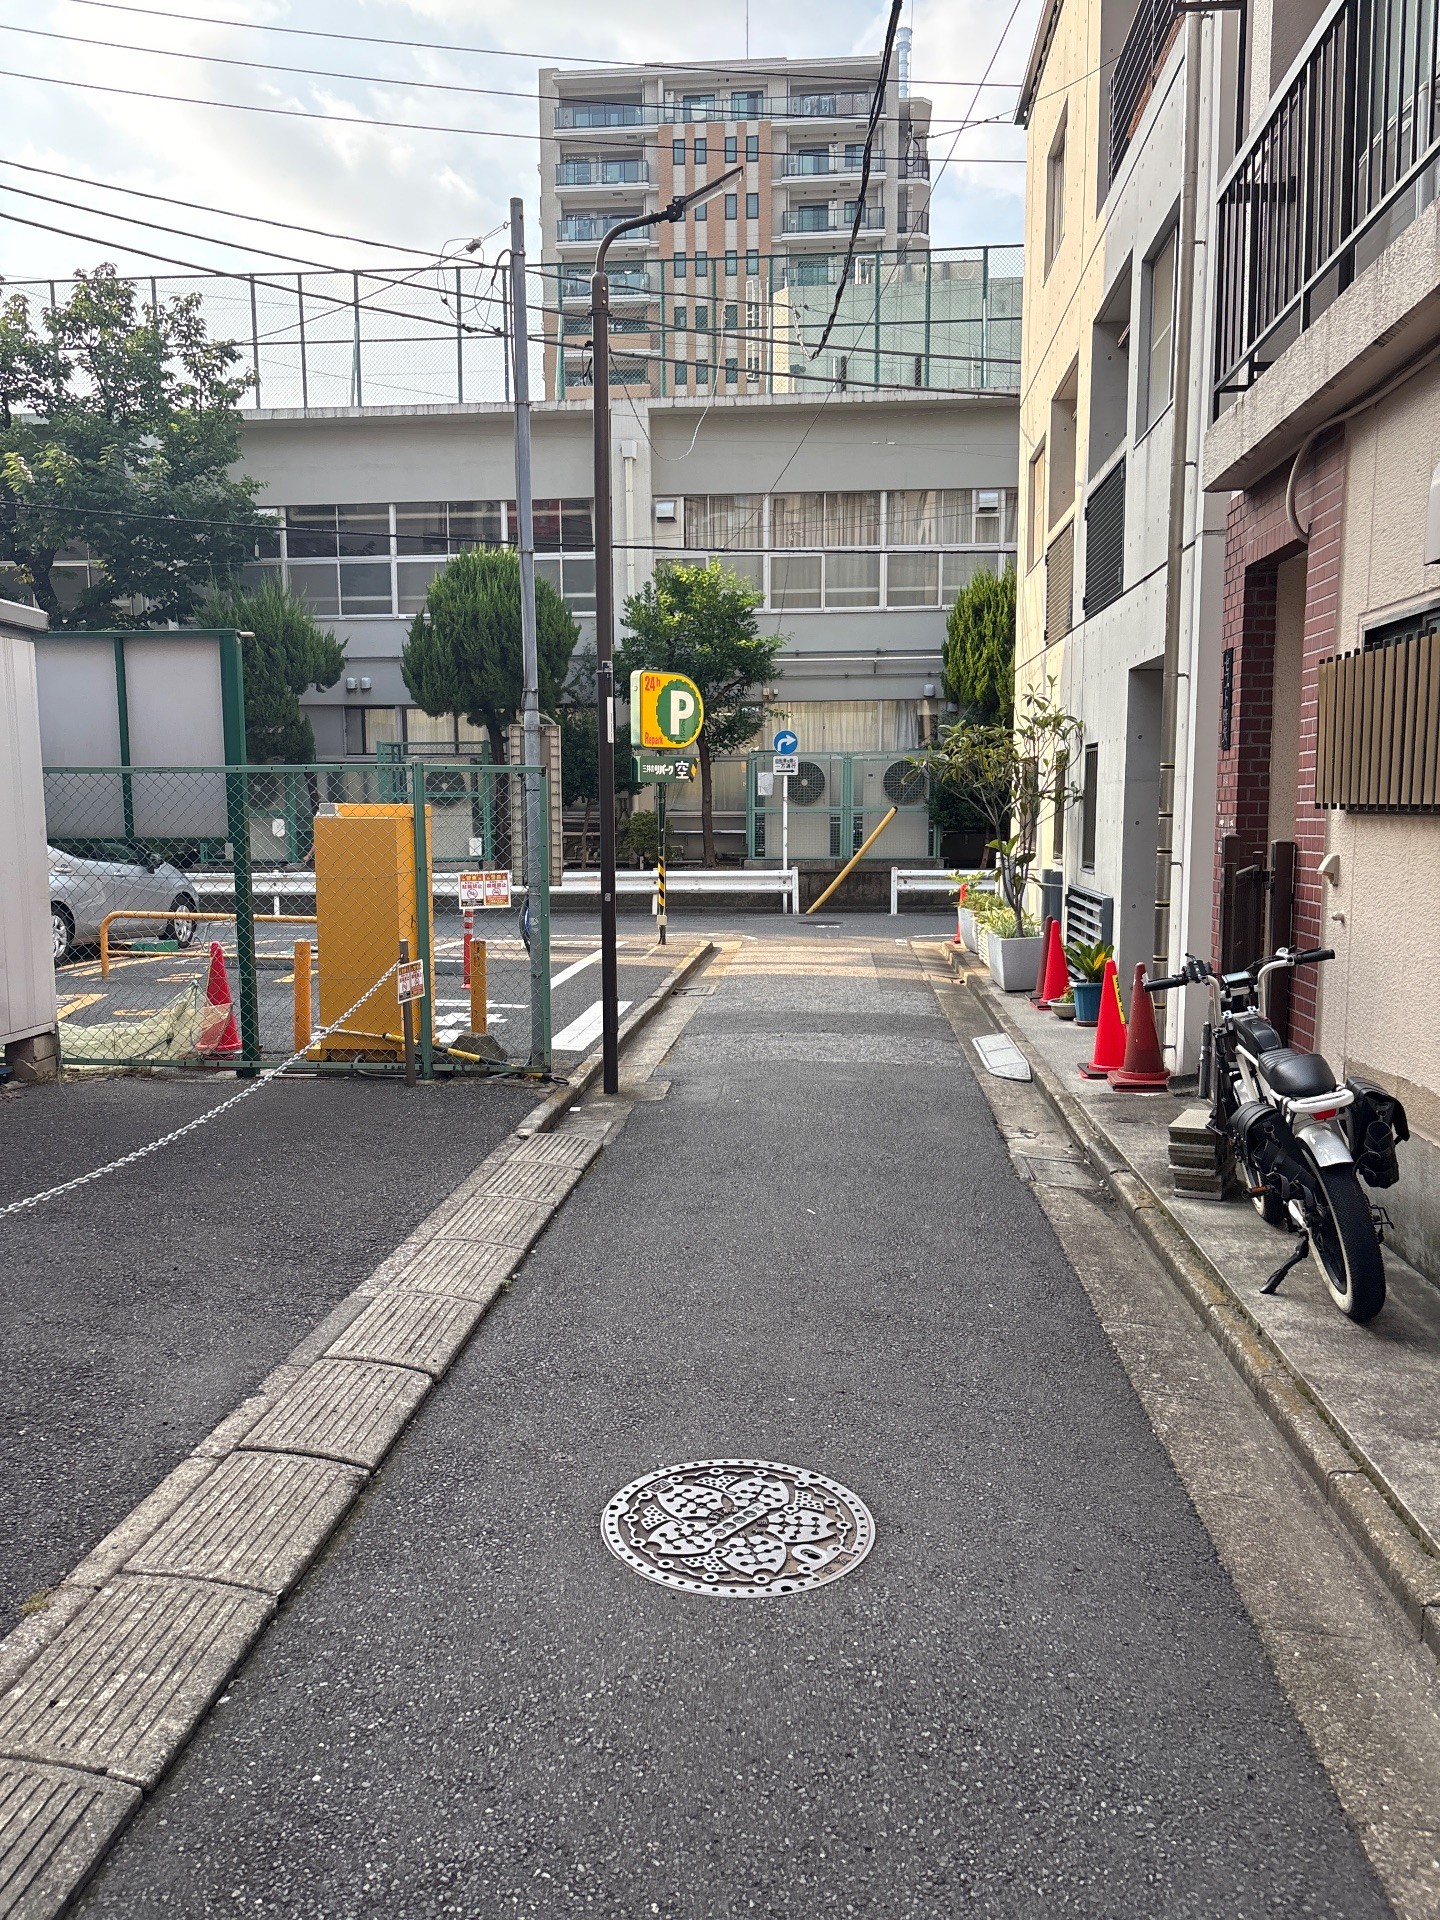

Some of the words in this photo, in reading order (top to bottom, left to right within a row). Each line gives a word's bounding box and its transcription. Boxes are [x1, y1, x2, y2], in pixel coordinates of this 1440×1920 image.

[644, 675, 661, 692] 24h
[670, 690, 695, 735] P
[644, 732, 664, 746] Repark
[642, 764, 674, 775] 三井のリパーク
[675, 760, 690, 780] 空
